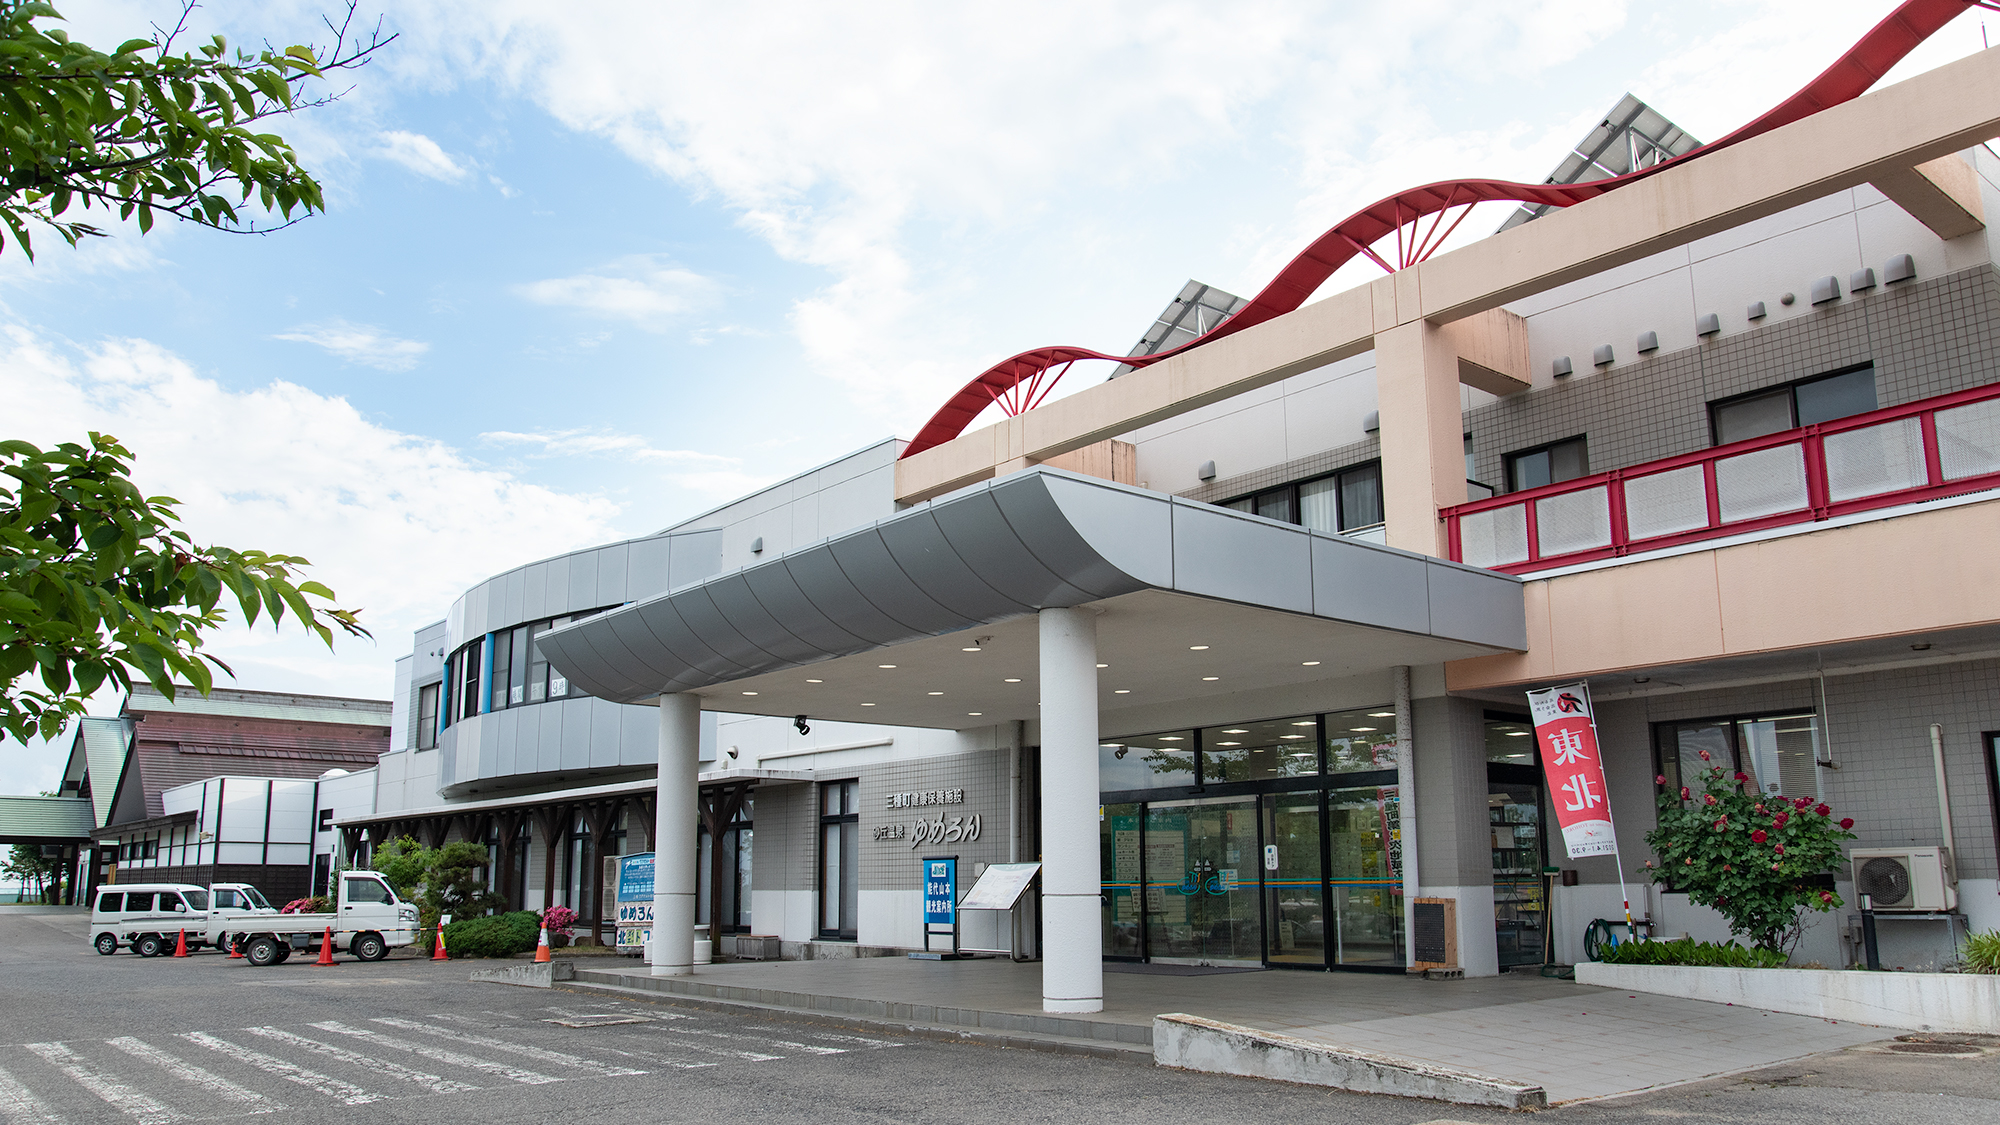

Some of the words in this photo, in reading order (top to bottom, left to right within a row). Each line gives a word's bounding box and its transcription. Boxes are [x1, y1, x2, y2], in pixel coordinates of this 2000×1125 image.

[911, 811, 982, 850] ゆめろん
[927, 882, 951, 896] 能代山本
[620, 906, 654, 921] ゆめろん
[926, 900, 952, 913] 観光案内所
